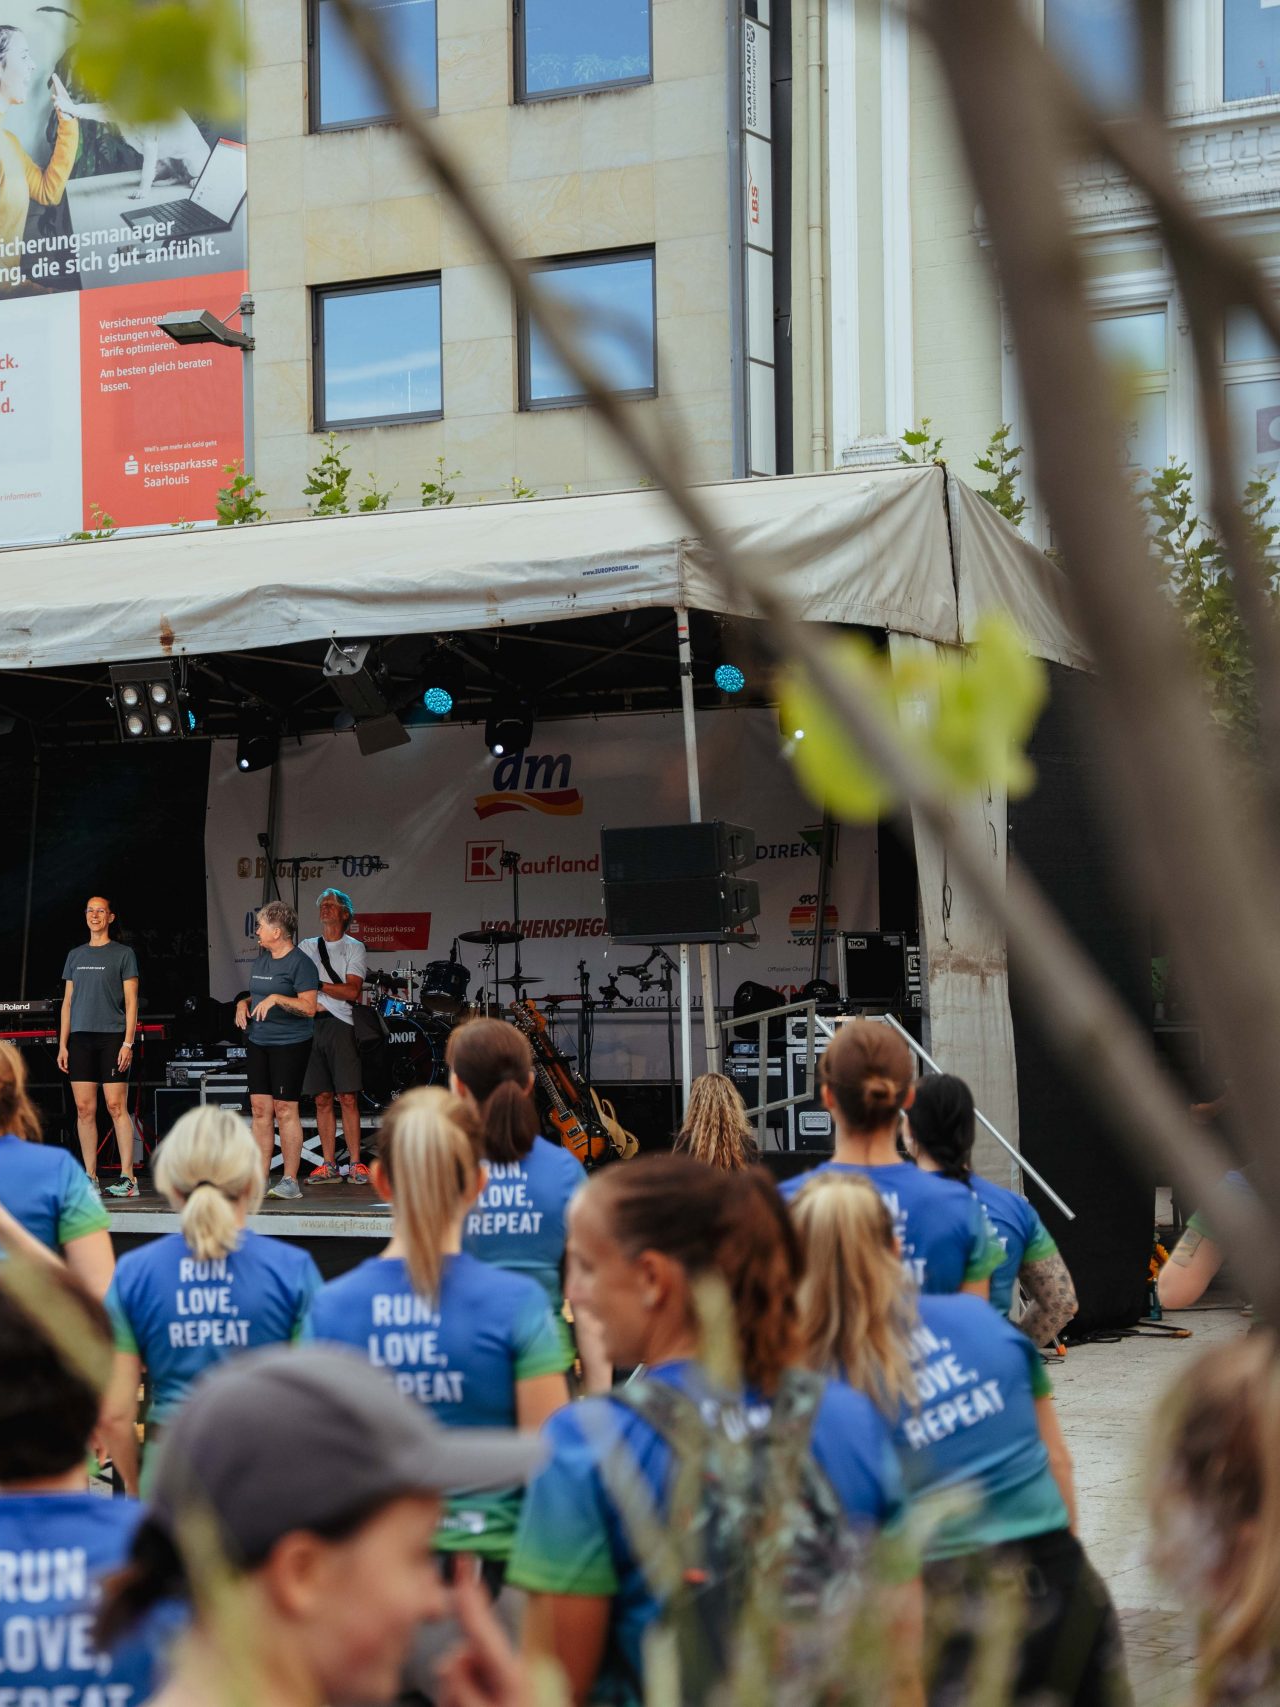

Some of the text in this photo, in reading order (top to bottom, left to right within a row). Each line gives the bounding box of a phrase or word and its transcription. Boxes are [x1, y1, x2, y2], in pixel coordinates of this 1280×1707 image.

[751, 185, 759, 224] LBS
[31, 257, 60, 279] die
[65, 253, 103, 275] sich
[108, 250, 140, 273] gut
[145, 237, 221, 264] anfühlt.
[100, 330, 149, 344] Leistungen
[100, 342, 177, 358] Tarife optimieren.
[100, 358, 212, 378] Am besten gleich beraten
[100, 382, 131, 392] lassen.
[144, 458, 218, 473] Kreissparkasse
[144, 474, 189, 488] Saarlouis
[363, 925, 416, 935] Kreissparkasse
[363, 935, 394, 943] Saarlouis
[467, 1211, 543, 1235] REPEAT
[179, 1257, 234, 1284] RUN,
[176, 1286, 239, 1317] LOVE,
[371, 1292, 441, 1328] RUN,
[168, 1319, 251, 1348] REPEAT
[367, 1331, 448, 1368] LOVE,
[396, 1370, 465, 1404] PEAT
[914, 1354, 979, 1401] OVE,
[903, 1379, 1005, 1450] REPEAT
